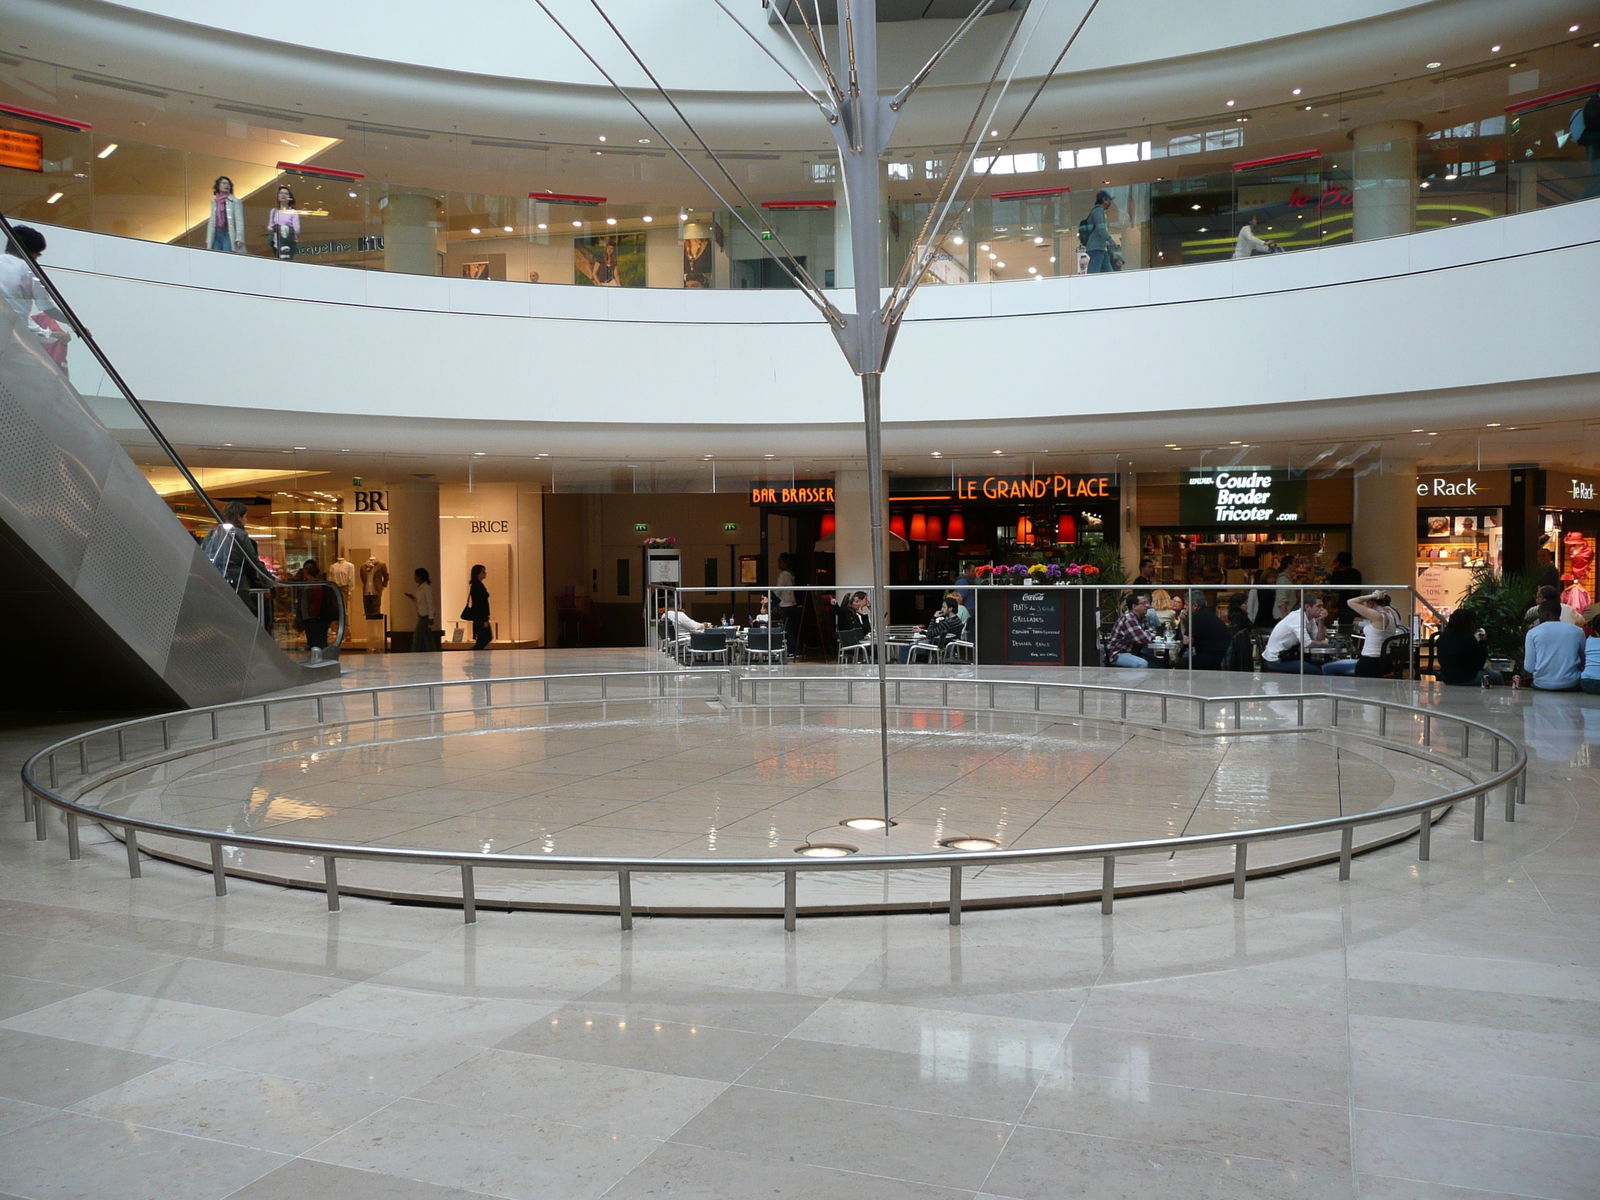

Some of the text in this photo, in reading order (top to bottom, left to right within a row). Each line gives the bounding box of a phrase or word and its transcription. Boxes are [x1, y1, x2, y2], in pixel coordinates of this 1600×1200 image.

[1287, 187, 1310, 208] le
[958, 477, 978, 500] LE
[1189, 472, 1272, 488] www. Coudre
[1433, 478, 1477, 496] Rack
[752, 488, 777, 503] BAR
[1217, 488, 1271, 505] Broder
[1580, 482, 1594, 501] Rack
[1215, 505, 1298, 521] Tricoter .com
[471, 520, 508, 533] BRICE
